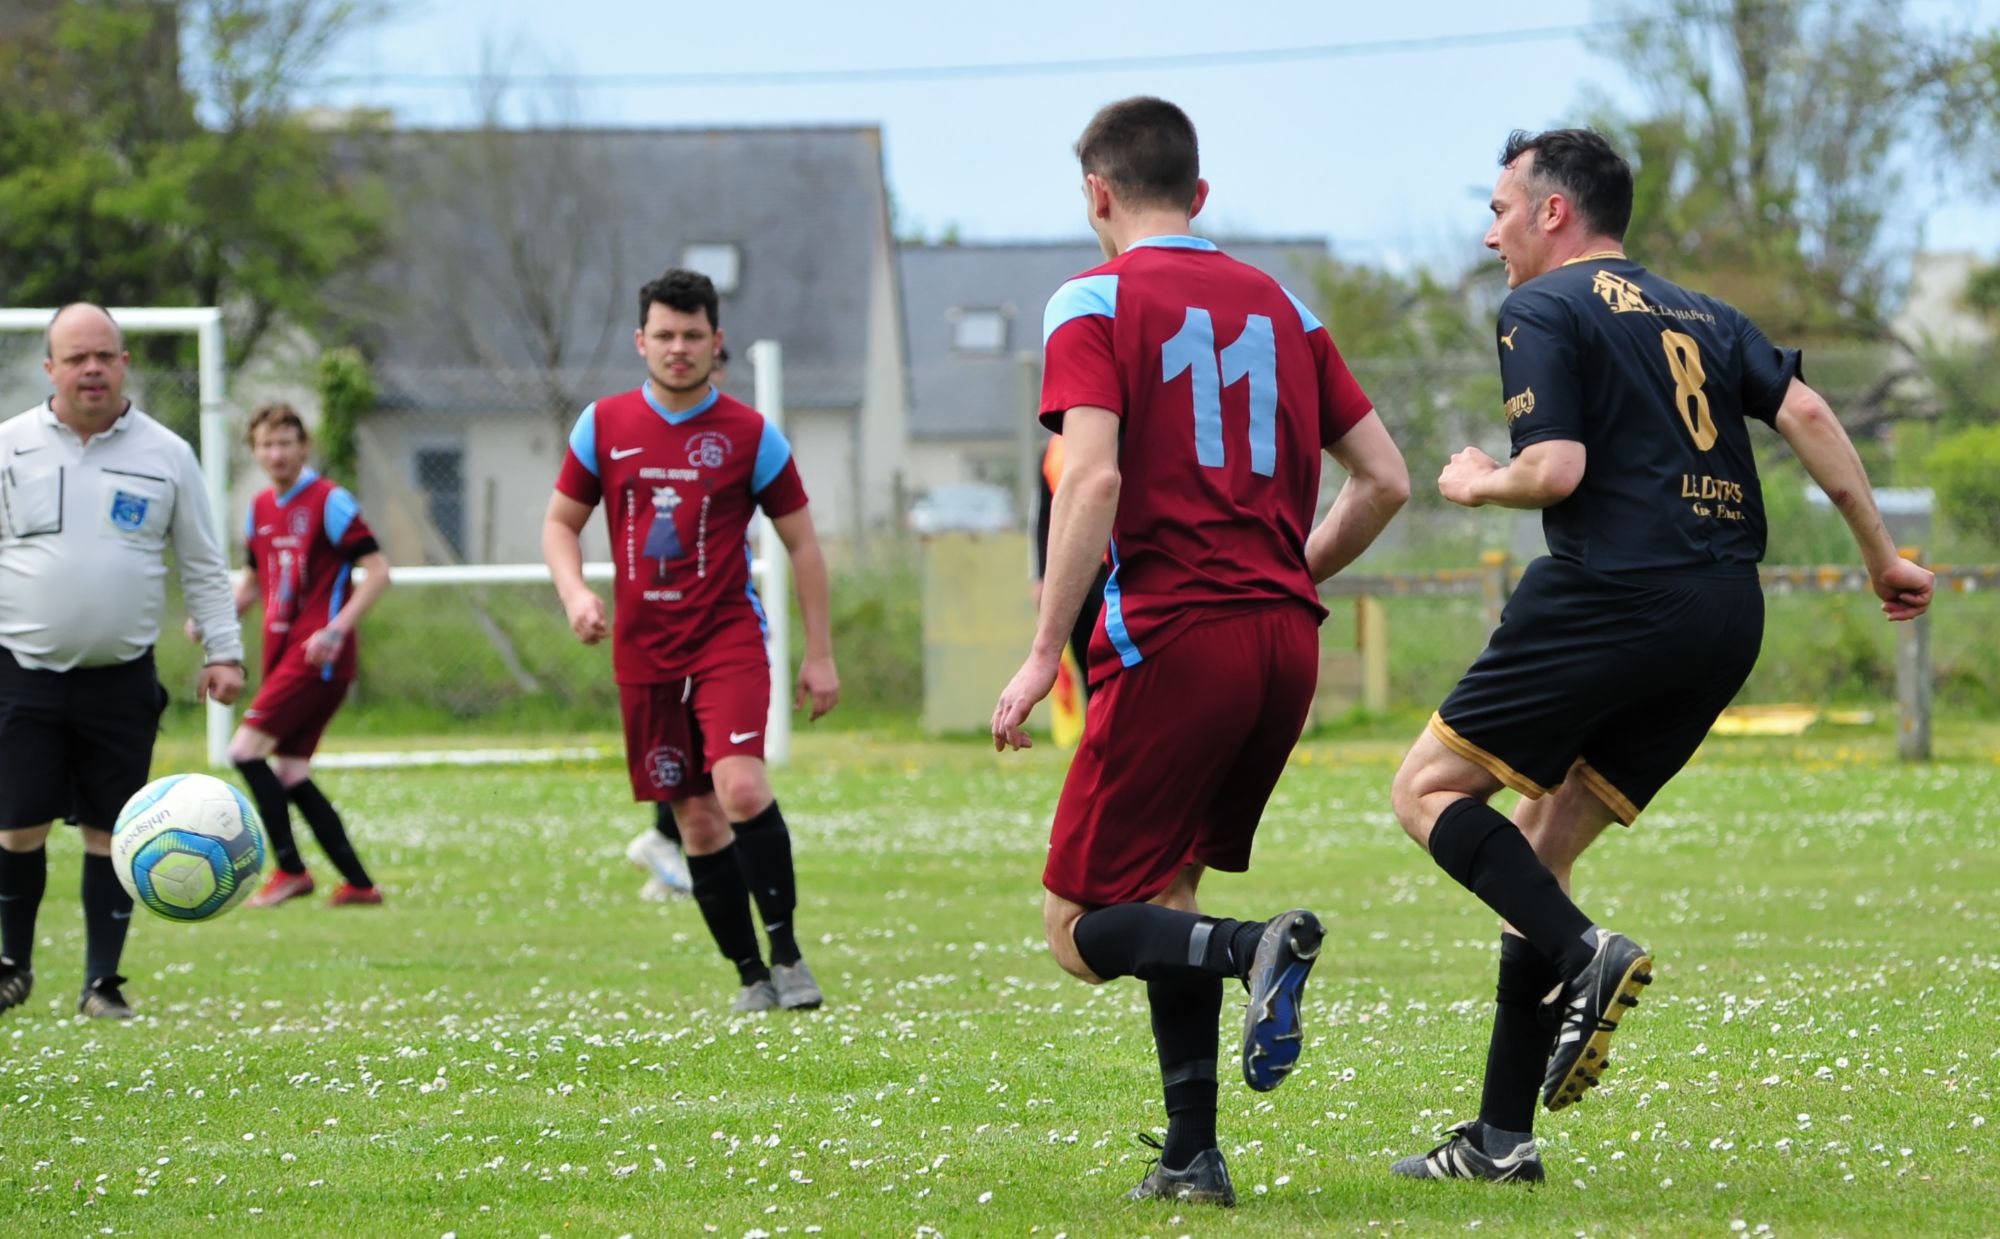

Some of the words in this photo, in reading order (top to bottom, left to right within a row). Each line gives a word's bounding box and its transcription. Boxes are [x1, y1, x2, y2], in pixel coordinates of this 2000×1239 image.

[1161, 305, 1279, 479] 11
[1660, 328, 1719, 452] 8
[119, 808, 171, 855] uhlsport
